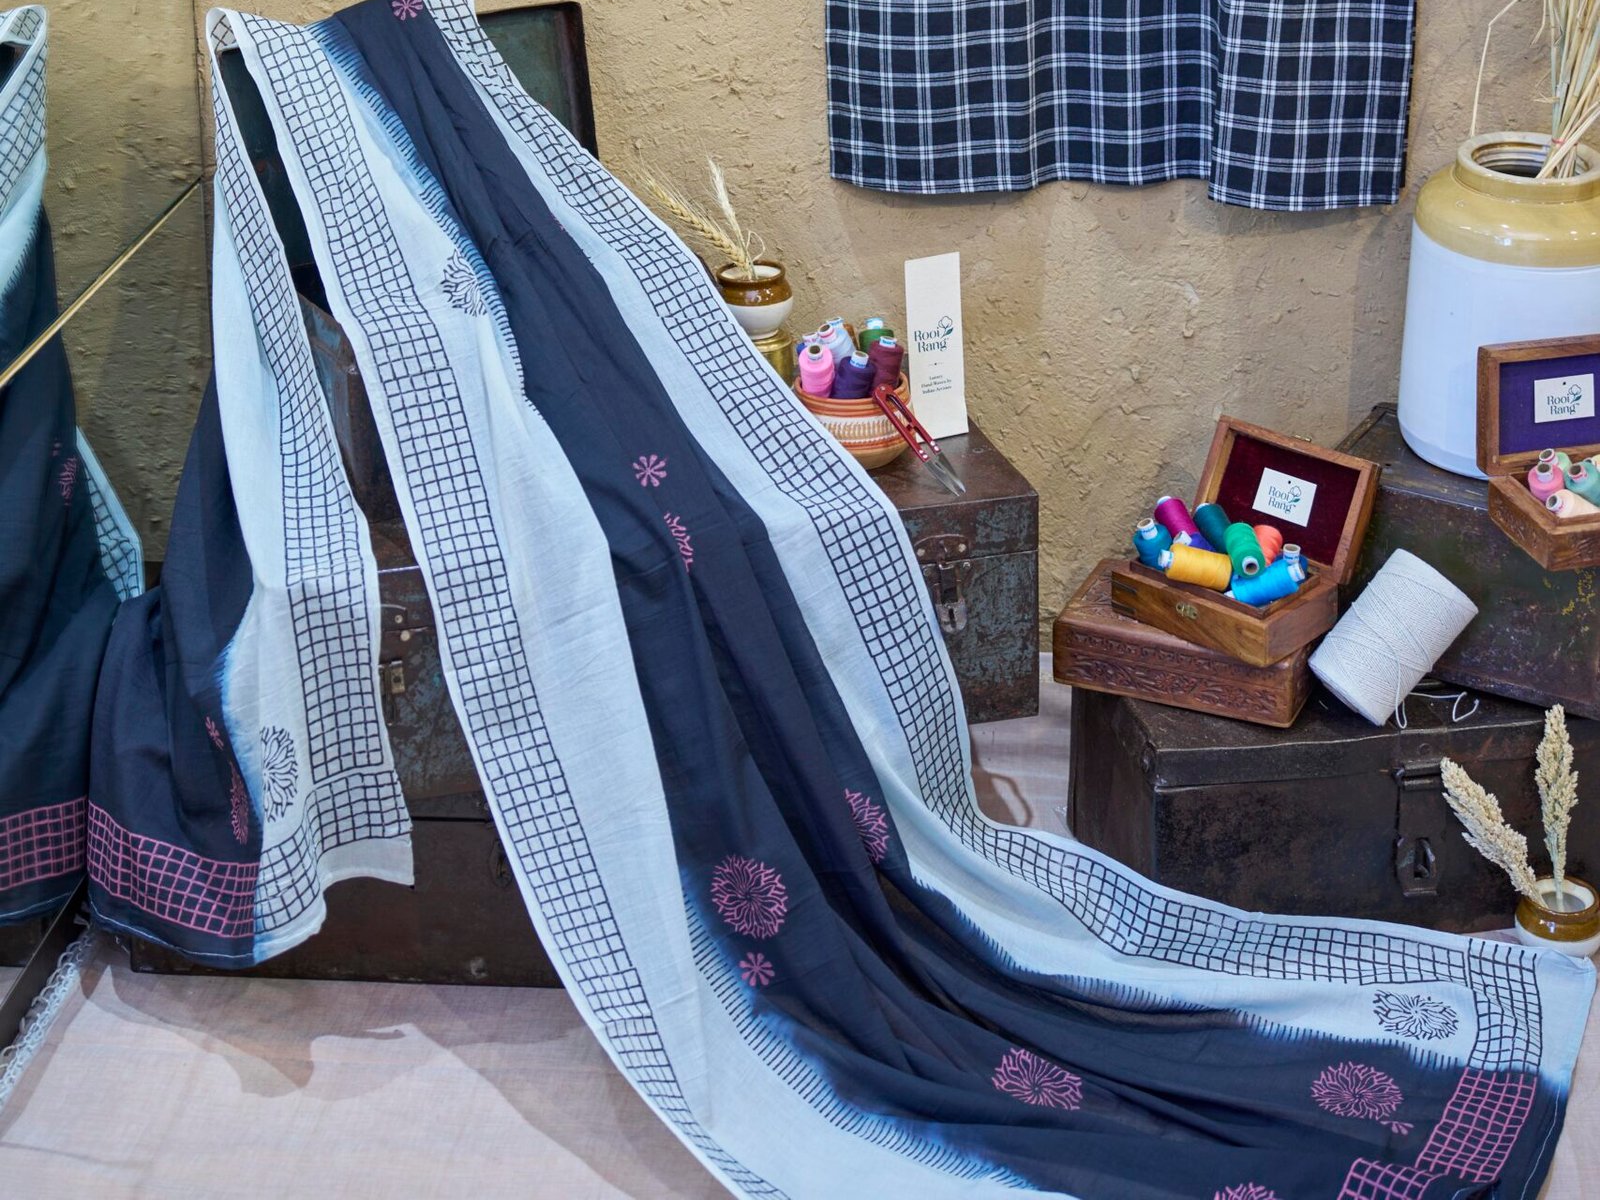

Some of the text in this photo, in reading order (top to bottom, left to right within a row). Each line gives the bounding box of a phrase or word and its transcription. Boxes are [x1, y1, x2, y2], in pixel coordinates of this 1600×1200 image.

[914, 327, 940, 341] Rooi
[917, 338, 947, 353] Rang
[1547, 393, 1570, 405] Rooi
[1550, 404, 1576, 415] Rang
[1268, 486, 1289, 502] Rooi
[1268, 497, 1292, 514] Rang
